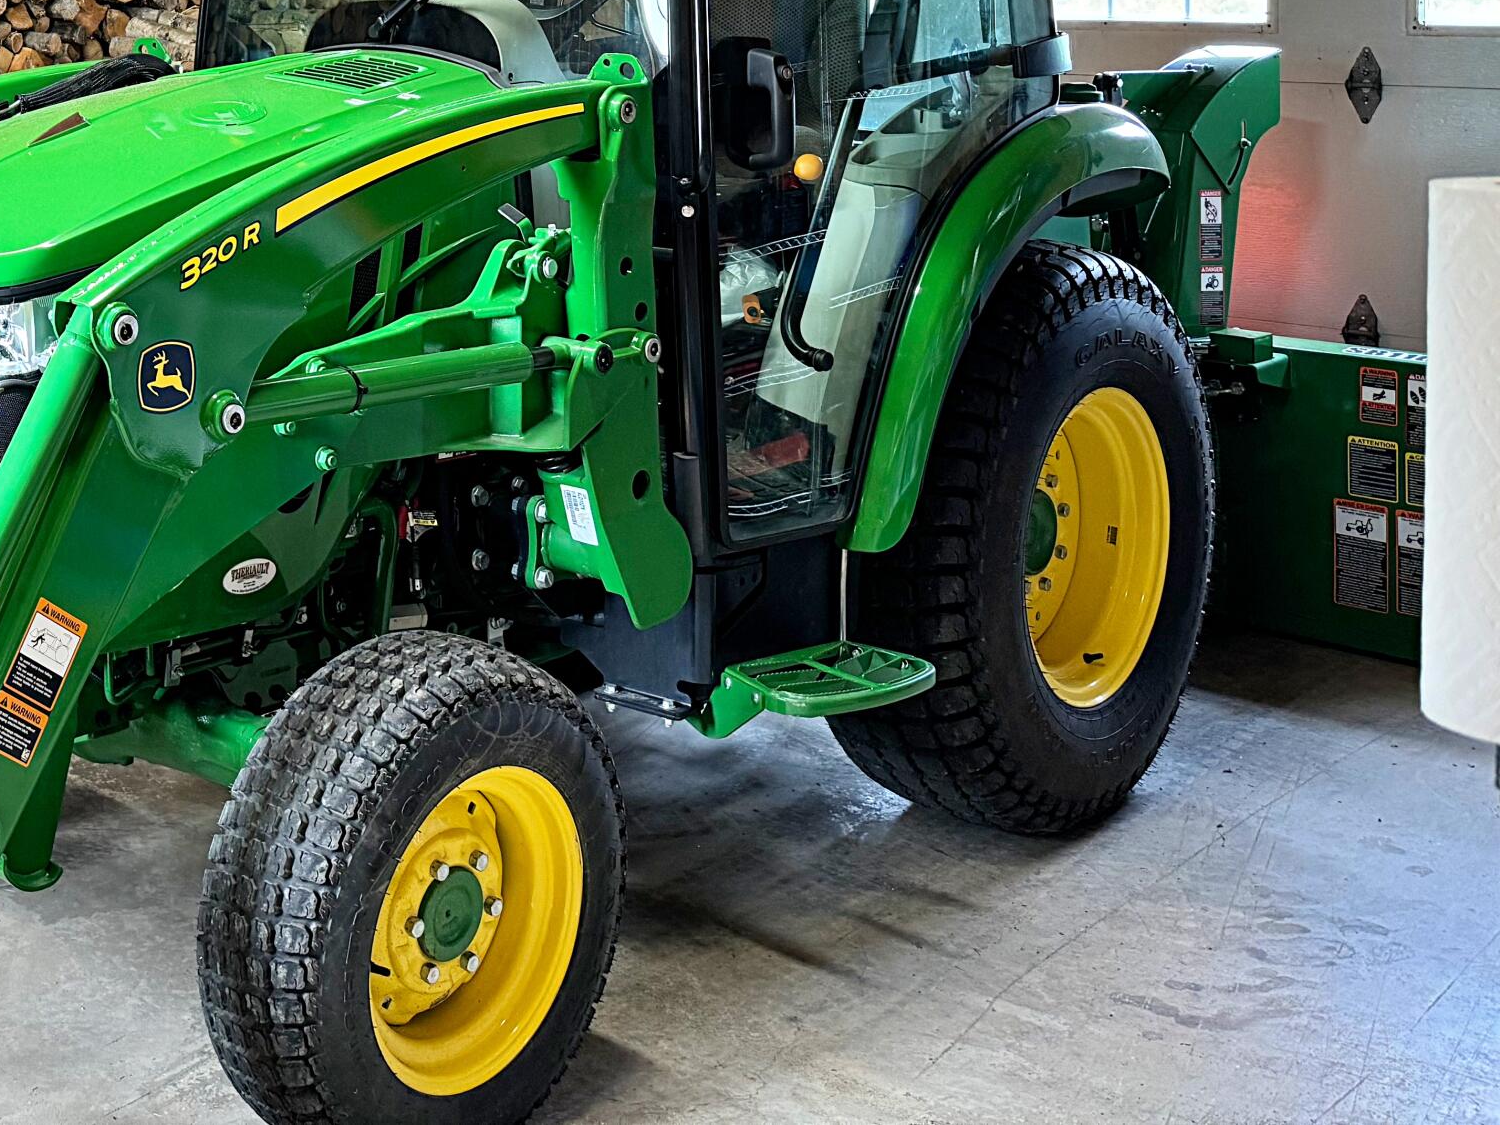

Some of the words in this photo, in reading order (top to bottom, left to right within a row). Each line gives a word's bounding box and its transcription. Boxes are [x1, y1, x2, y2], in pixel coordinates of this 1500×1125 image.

[180, 235, 238, 291] 320
[242, 221, 261, 252] R
[1357, 438, 1396, 450] ATTENTION
[231, 561, 270, 582] THERIAULT
[50, 608, 81, 632] WARNING
[10, 701, 42, 725] WARNING
